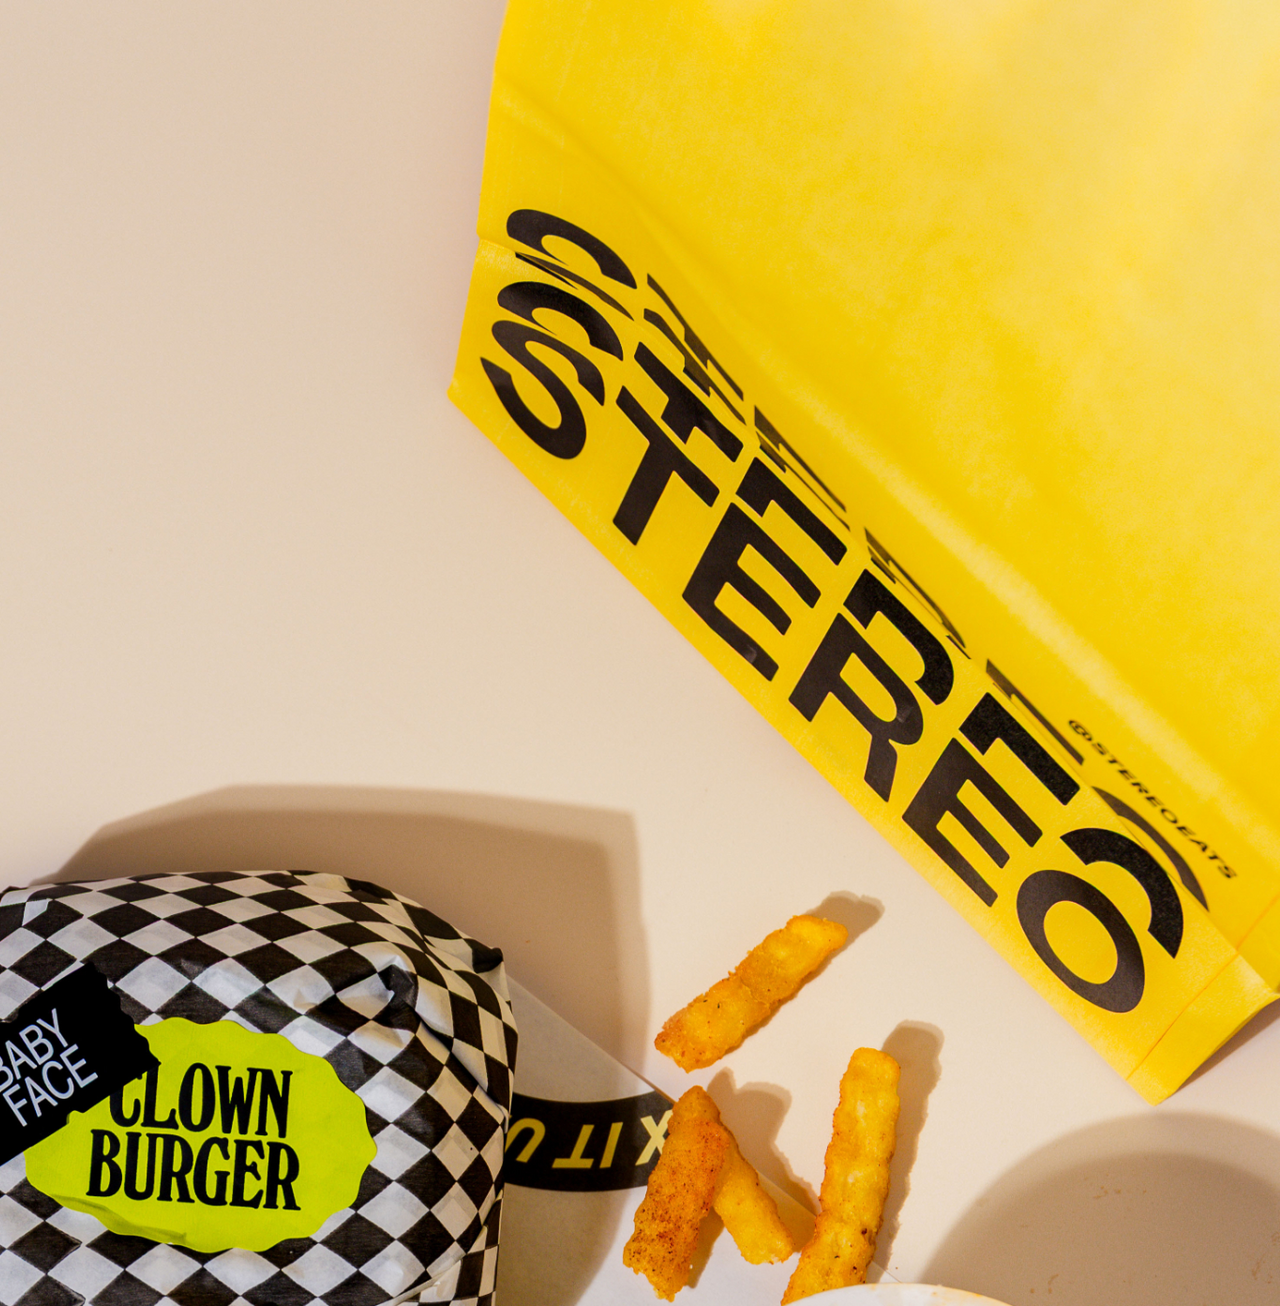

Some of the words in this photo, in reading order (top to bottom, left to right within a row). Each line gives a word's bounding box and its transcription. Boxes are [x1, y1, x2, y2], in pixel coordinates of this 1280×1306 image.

[479, 319, 1147, 1014] STEREO
[1067, 719, 1238, 879] @STEREOEATS
[1, 1043, 99, 1128] FACE
[85, 1128, 302, 1211] BURGER
[551, 1121, 624, 1169] IT
